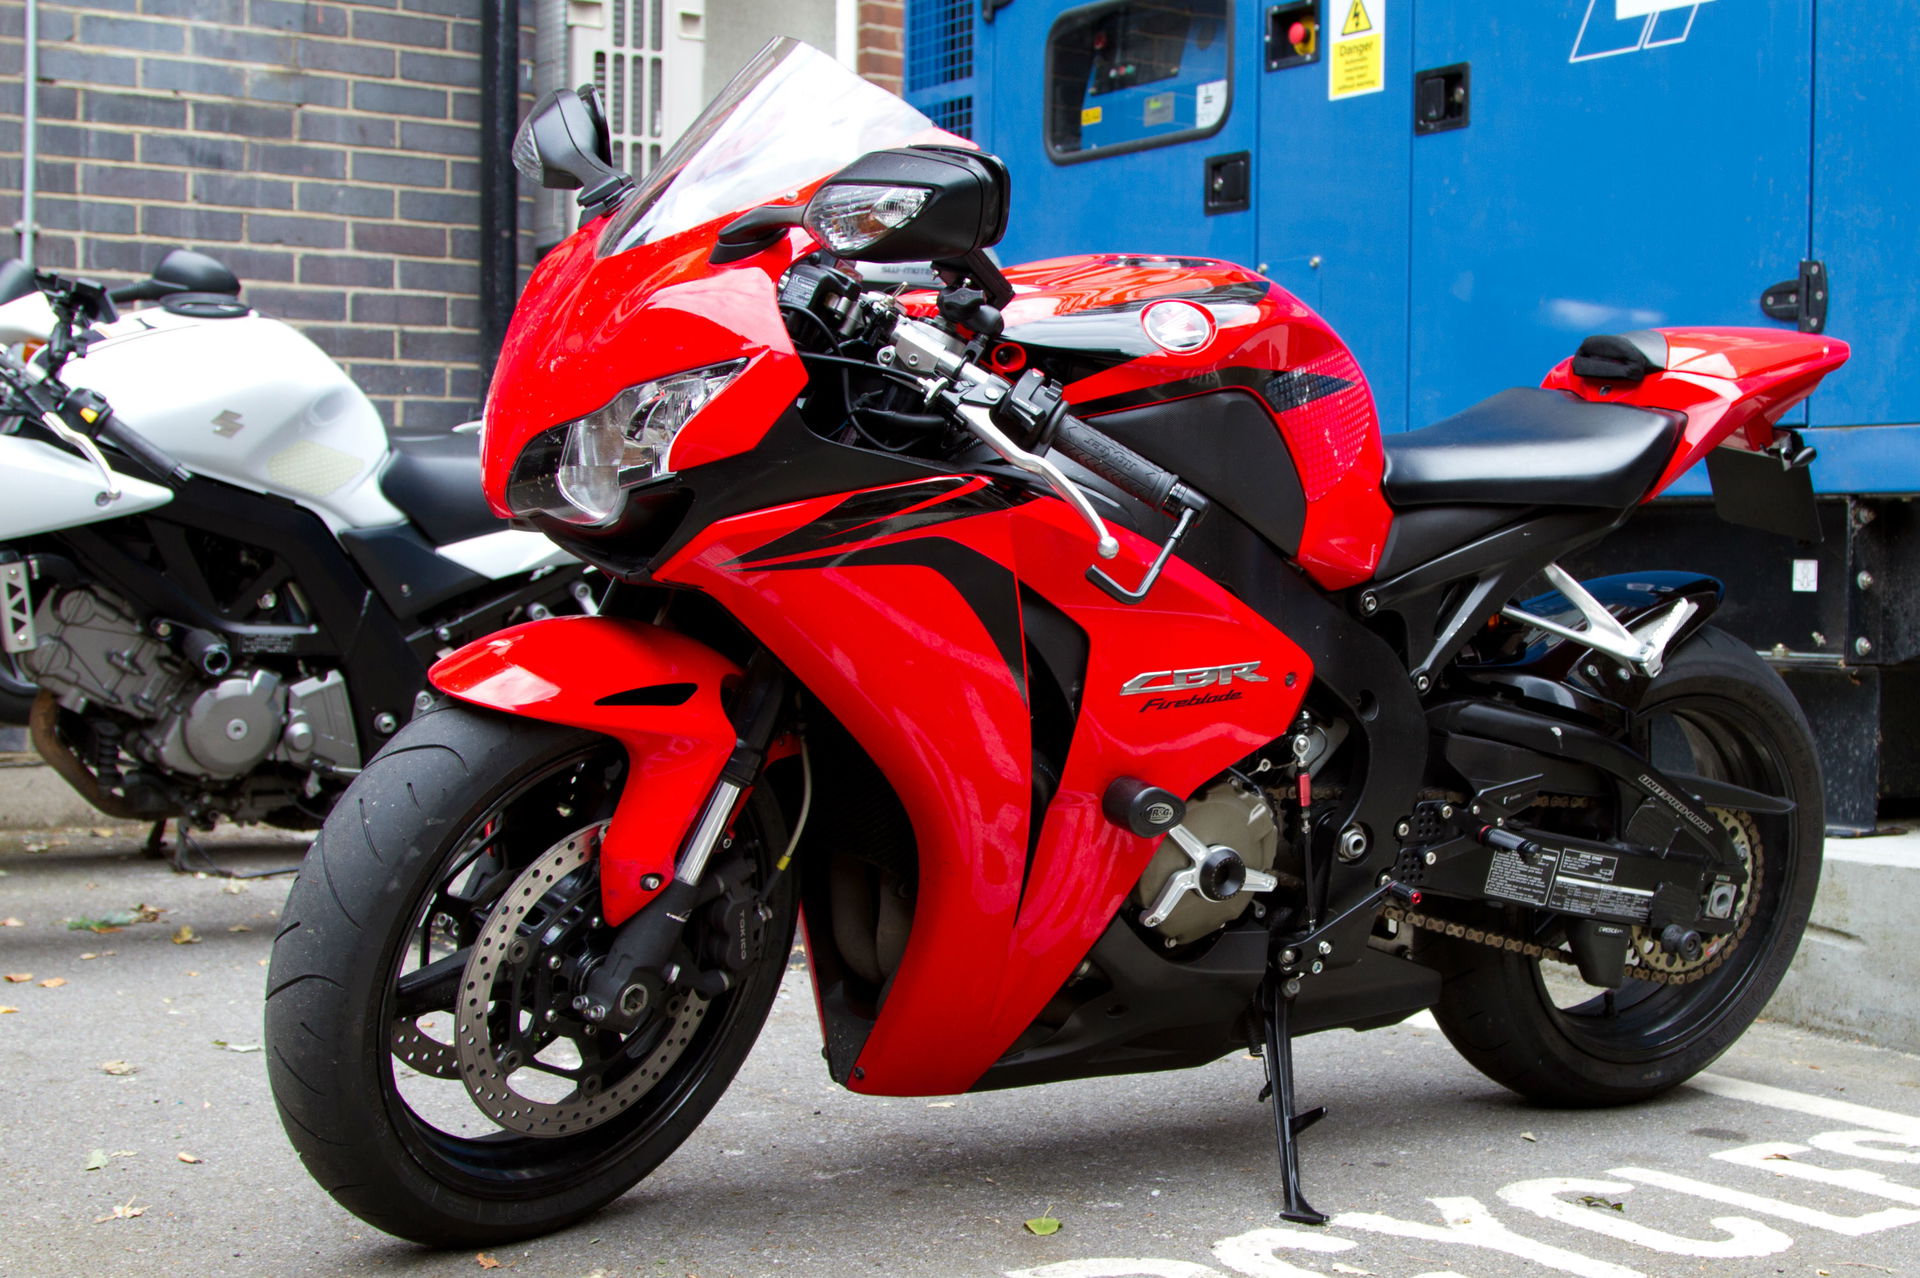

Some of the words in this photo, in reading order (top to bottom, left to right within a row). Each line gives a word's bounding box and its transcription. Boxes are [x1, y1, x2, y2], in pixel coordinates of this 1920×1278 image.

[1339, 41, 1374, 57] Danger
[1120, 661, 1268, 695] CBR
[1139, 690, 1242, 713] Fireblade
[739, 910, 747, 960] TOKICO
